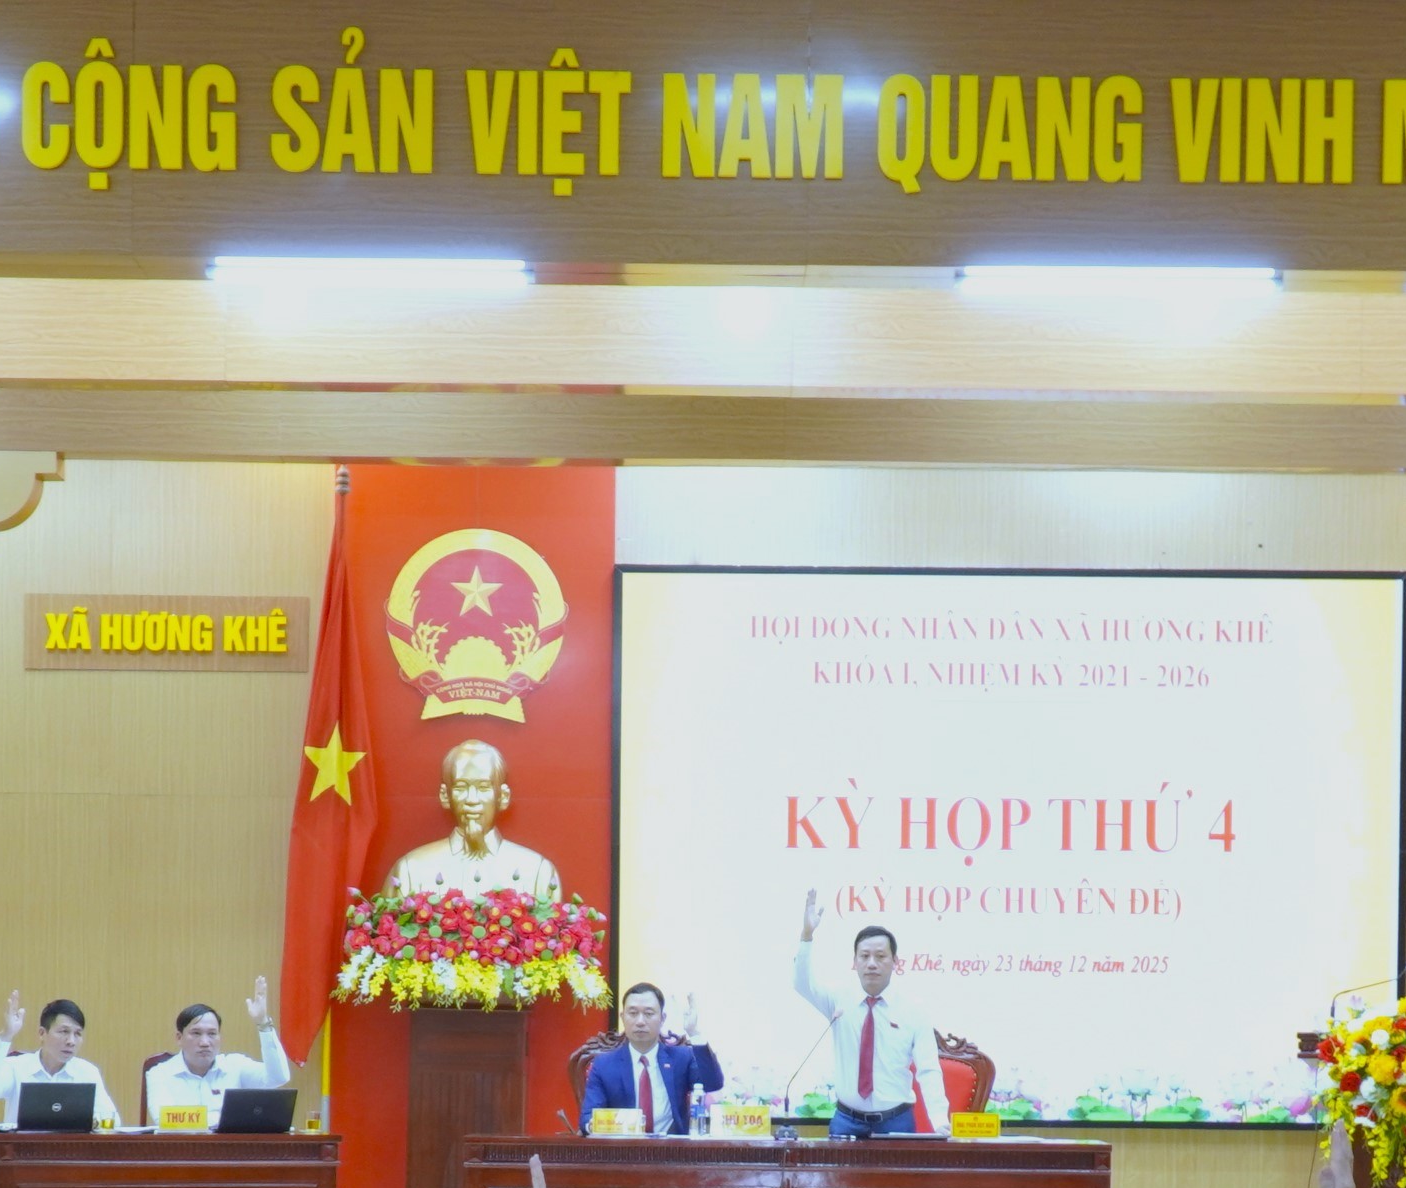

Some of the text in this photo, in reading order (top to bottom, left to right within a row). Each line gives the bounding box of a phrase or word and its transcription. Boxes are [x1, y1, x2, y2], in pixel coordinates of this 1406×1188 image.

[21, 37, 238, 190] CỘNG
[270, 26, 434, 176] SẢN
[465, 48, 632, 197] VIỆT
[662, 72, 844, 180] NAM
[877, 74, 1144, 194] QUANG
[1171, 77, 1354, 185] VINH
[45, 606, 288, 652] XÃ HƯƠNG KHÊ
[1214, 612, 1273, 644] KHÊ
[1078, 664, 1129, 687] 2021
[1156, 665, 1210, 688] 2026
[785, 777, 1237, 867] KỲ HỌP THỨ 4
[835, 876, 893, 921] (KỲ
[904, 885, 972, 922] HỌP
[979, 877, 1118, 916] CHUYÊN
[910, 953, 946, 974] Khê,
[952, 955, 991, 977] ngày
[995, 954, 1013, 972] 23
[1018, 953, 1063, 977] tháng
[1070, 955, 1087, 973] 12
[1092, 956, 1125, 973] năm
[1131, 956, 1170, 973] 2025
[166, 1112, 185, 1125] THƯ
